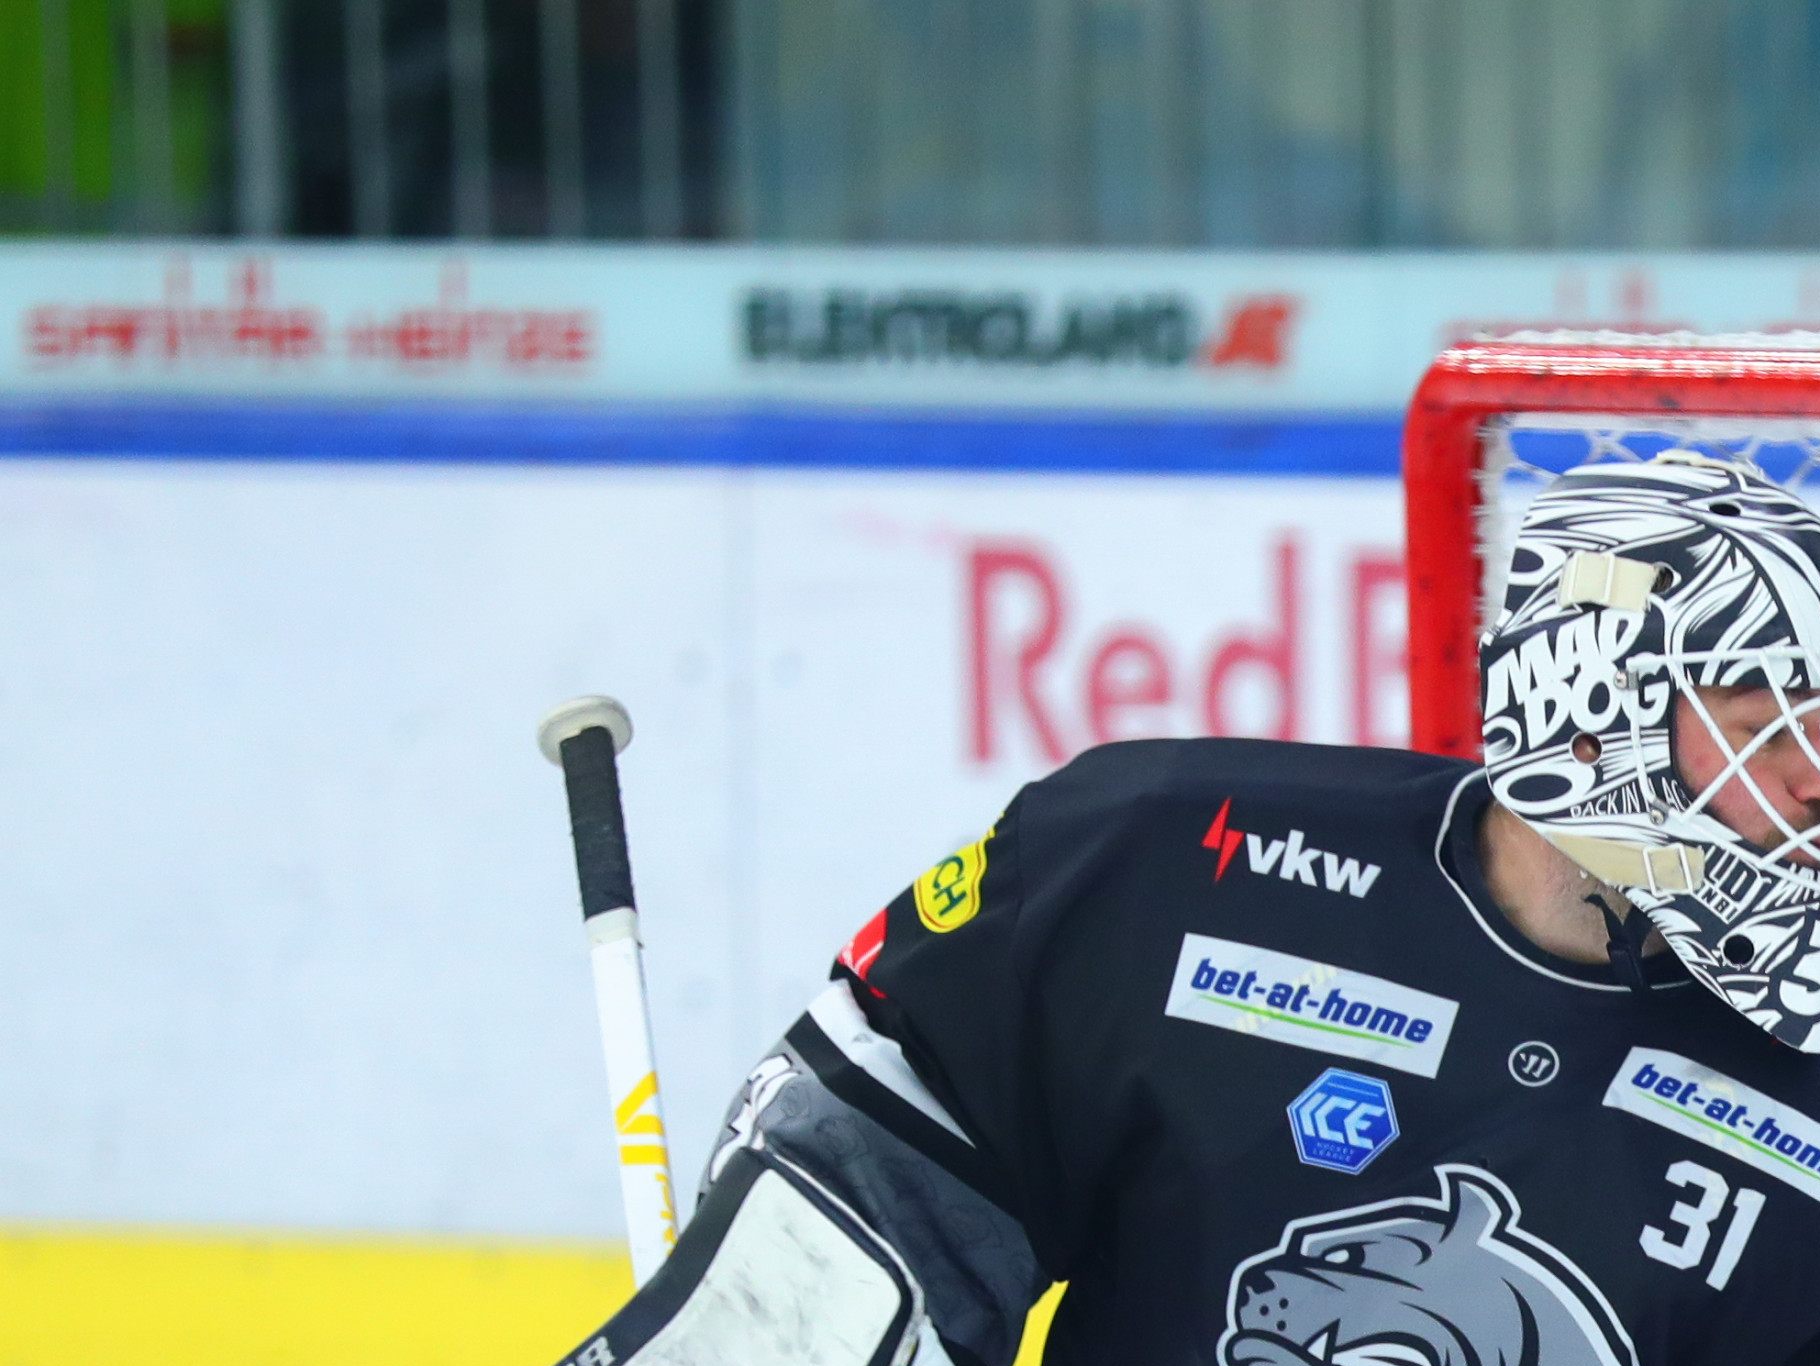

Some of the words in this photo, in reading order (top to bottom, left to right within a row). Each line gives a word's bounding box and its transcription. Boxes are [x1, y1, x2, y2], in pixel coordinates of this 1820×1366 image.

[1246, 830, 1381, 899] vkw
[1190, 957, 1434, 1046] bet-at-home
[1300, 1091, 1387, 1150] ICE
[1639, 1160, 1766, 1291] 31
